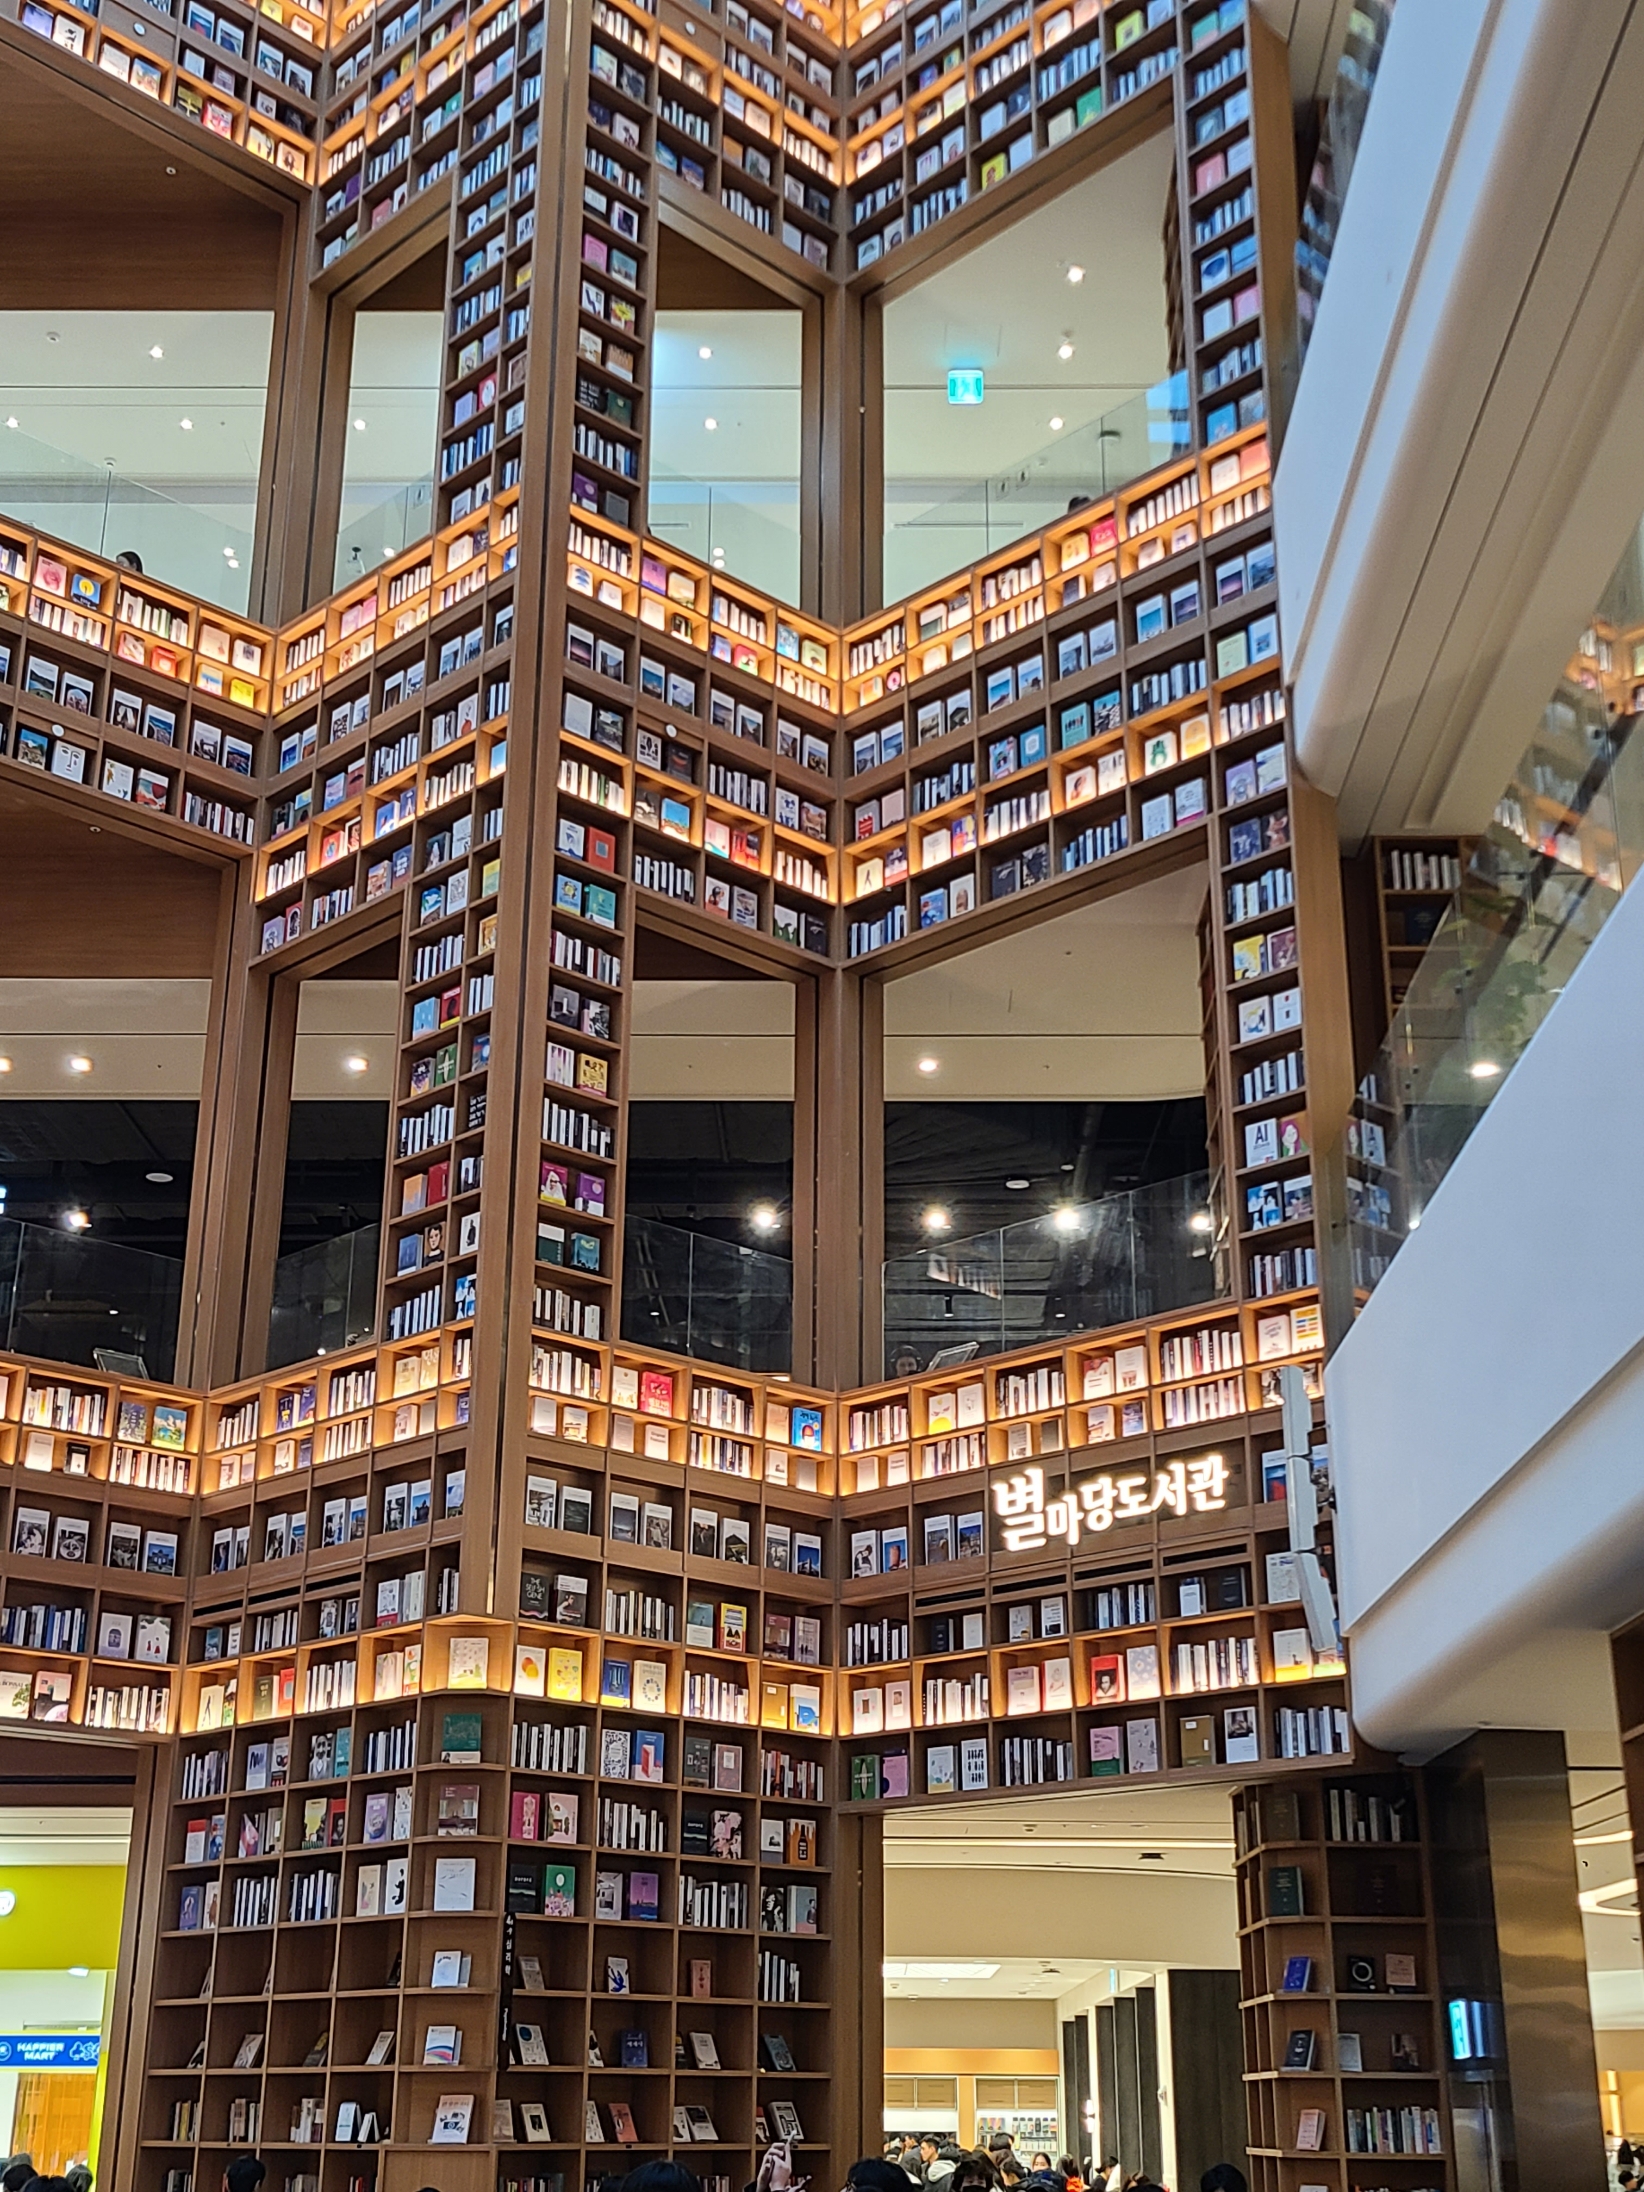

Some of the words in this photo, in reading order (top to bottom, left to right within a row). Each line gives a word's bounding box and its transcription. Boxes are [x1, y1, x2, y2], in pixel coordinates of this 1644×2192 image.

[1255, 1123, 1269, 1145] AI
[991, 1453, 1230, 1551] 별마당도서관
[526, 1590, 543, 1601] GENE
[17, 2042, 65, 2052] HAPPIER
[24, 2052, 55, 2061] MART
